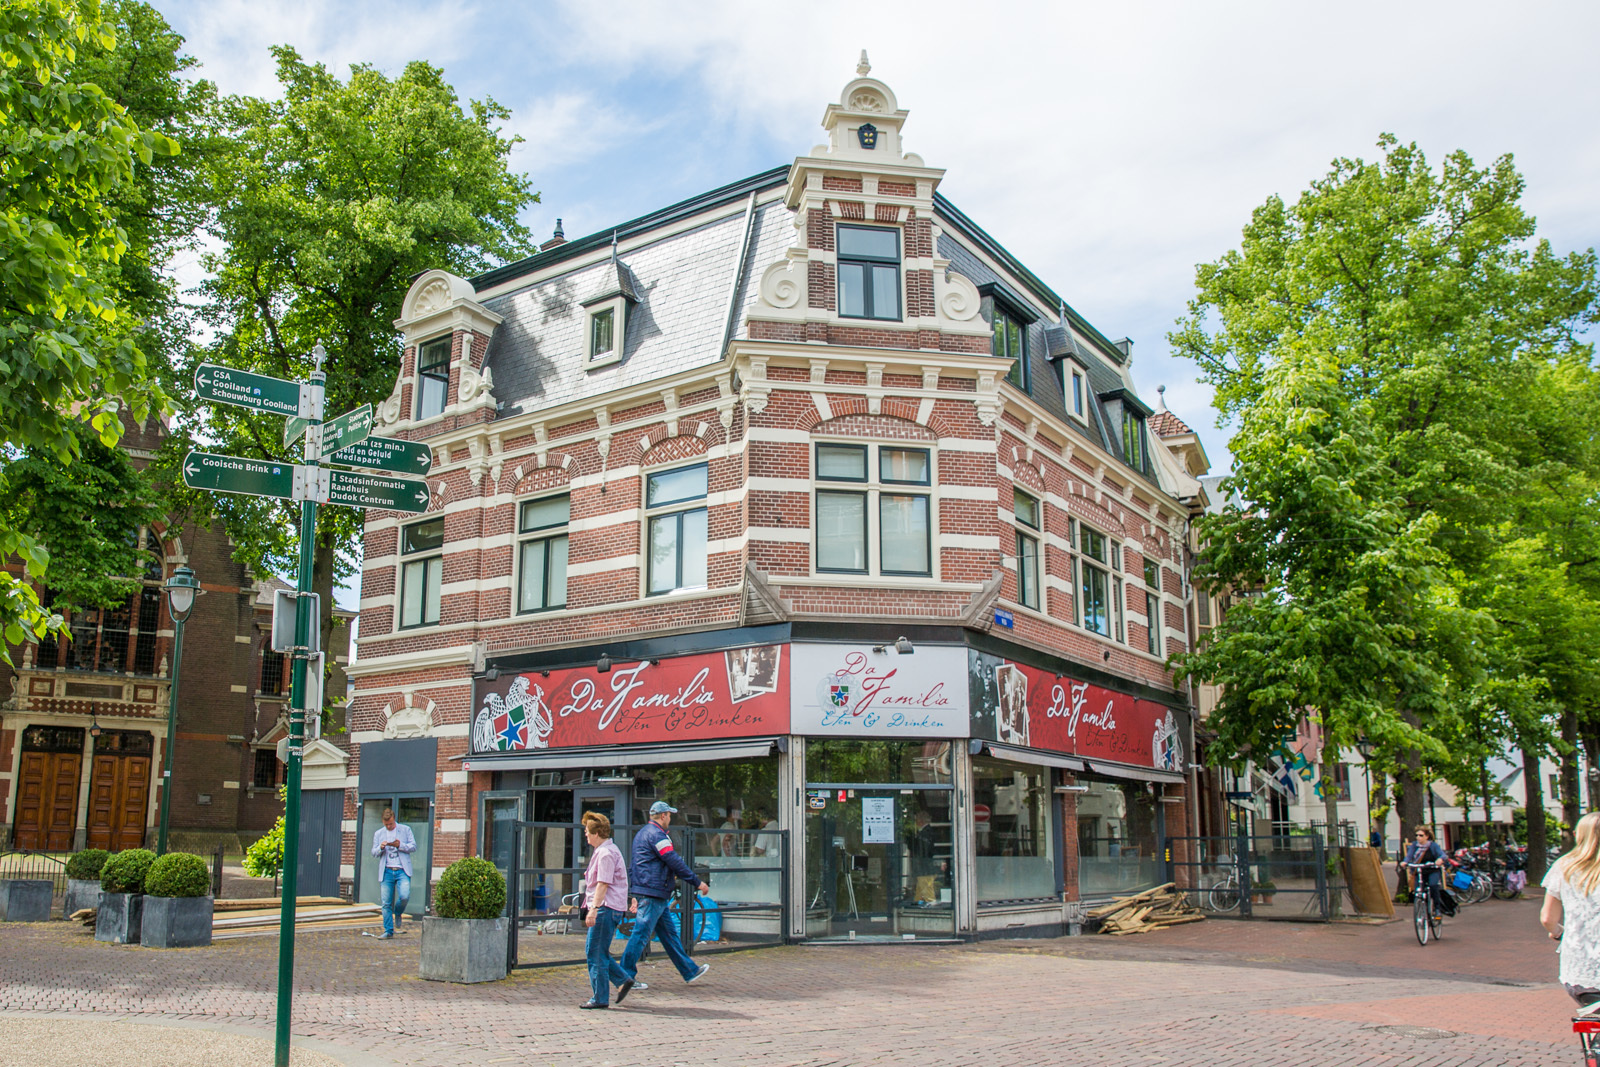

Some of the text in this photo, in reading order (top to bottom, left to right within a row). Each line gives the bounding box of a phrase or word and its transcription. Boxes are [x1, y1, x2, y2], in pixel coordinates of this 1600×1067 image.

[214, 370, 230, 380] GSA
[212, 380, 250, 394] Gooiland
[212, 388, 297, 412] Schouwburg Gooiland
[368, 449, 391, 459] Geluid
[384, 443, 405, 452] min.)
[336, 452, 381, 464] Mediapark
[202, 458, 269, 474] Gooische Brink
[331, 484, 369, 494] Raadhuis
[340, 475, 406, 490] Stadsinformatie
[331, 492, 394, 505] Dudok Centrum
[836, 652, 876, 676] Da
[560, 660, 714, 730] Da Familia
[853, 668, 948, 716] Familia
[1047, 682, 1116, 737] Da Familia
[614, 705, 763, 733] Eten & Drinken
[821, 710, 944, 728] Eten & Drinken
